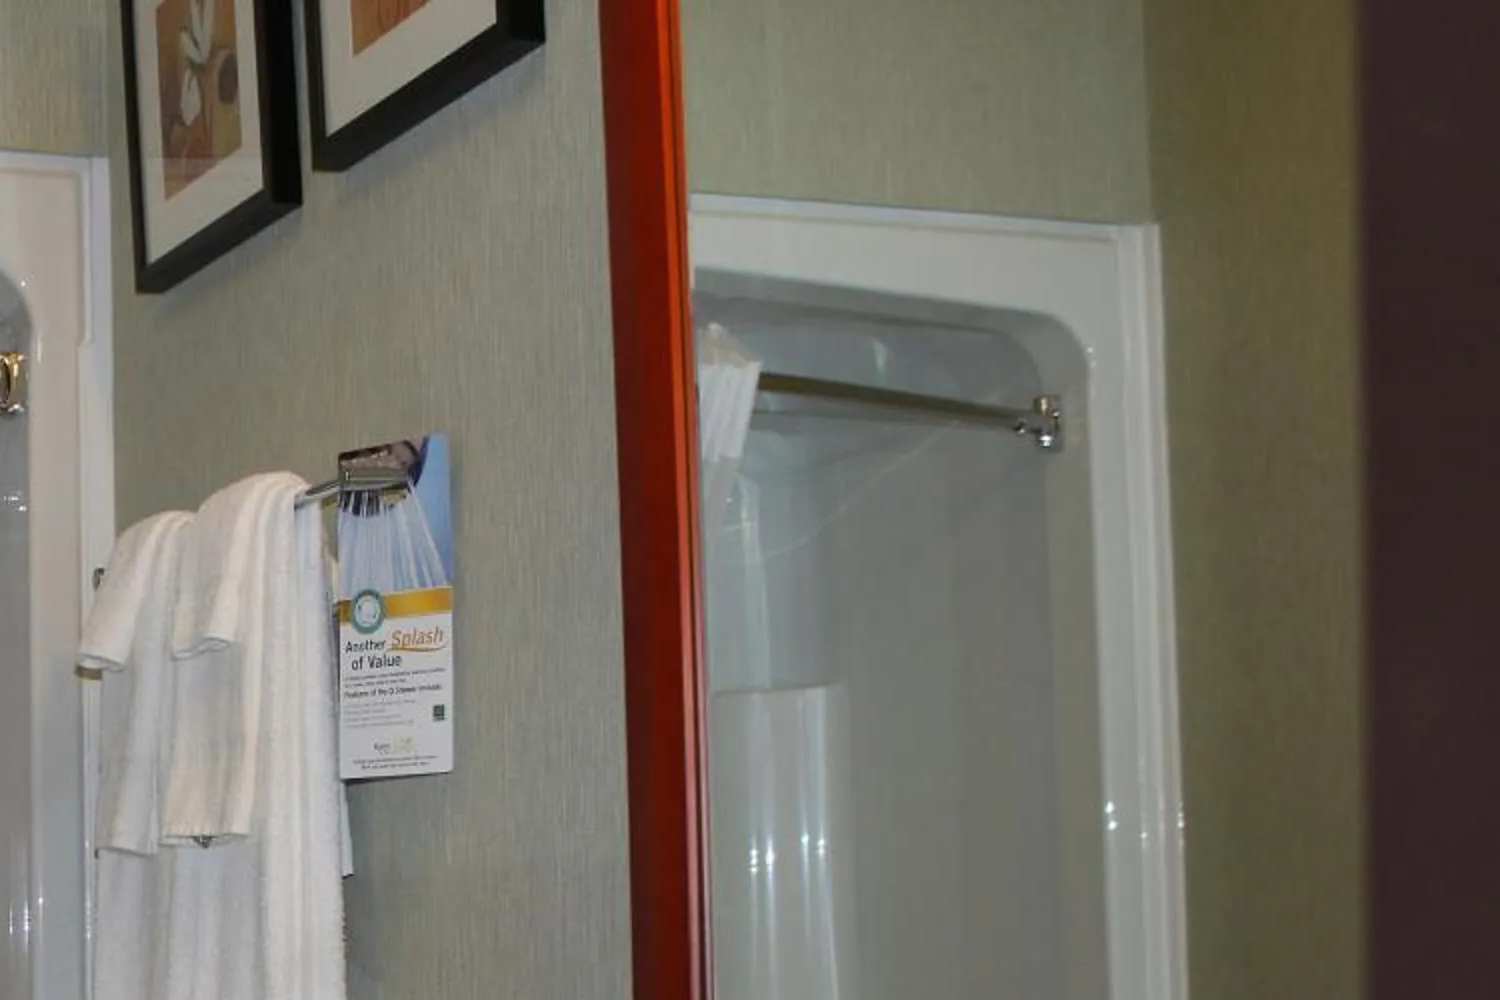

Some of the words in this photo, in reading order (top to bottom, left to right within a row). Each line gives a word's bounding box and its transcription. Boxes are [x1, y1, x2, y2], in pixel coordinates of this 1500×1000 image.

[345, 639, 386, 653] Another
[391, 626, 444, 648] Splash
[351, 656, 363, 670] of
[368, 654, 402, 669] Value
